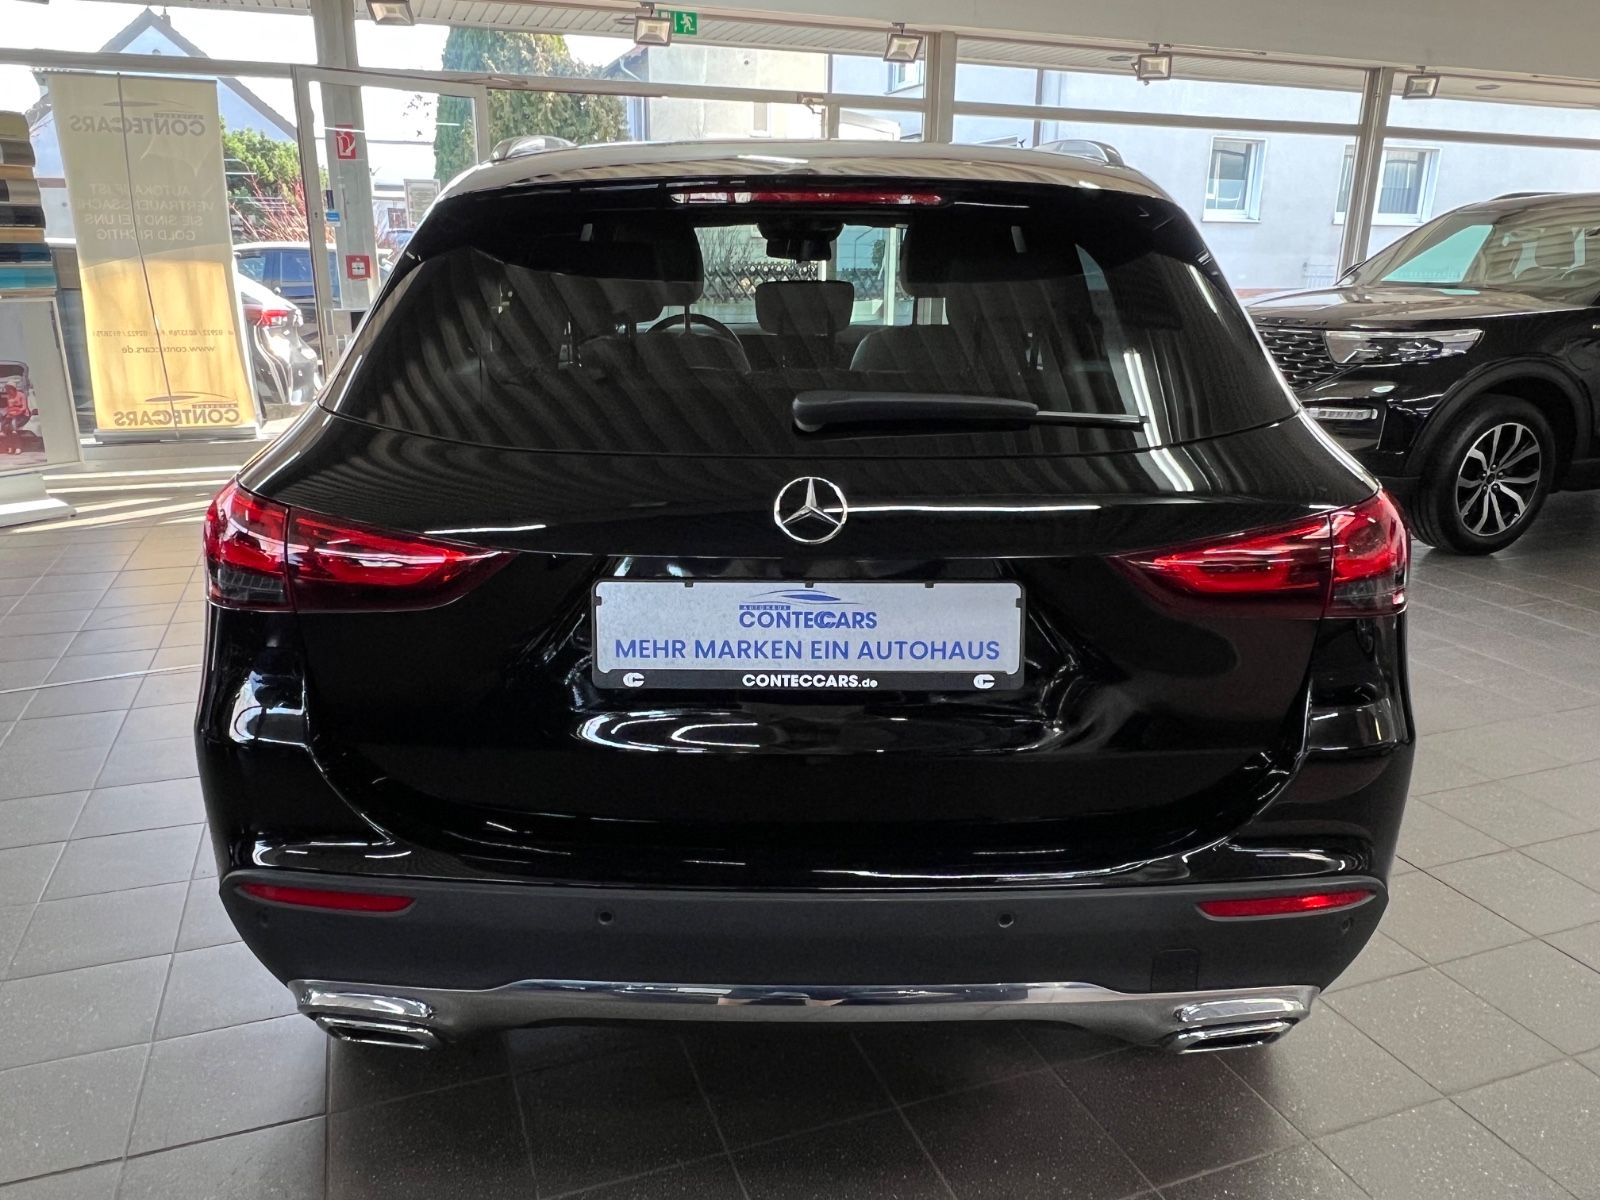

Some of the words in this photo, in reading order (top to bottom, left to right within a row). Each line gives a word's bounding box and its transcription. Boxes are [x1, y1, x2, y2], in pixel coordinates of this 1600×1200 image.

[615, 640, 686, 659] MEHR
[695, 640, 801, 659] MARKEN
[811, 640, 848, 660] EIN
[857, 640, 1000, 661] AUTOHAUS
[742, 674, 878, 689] CONTECCARS.de
